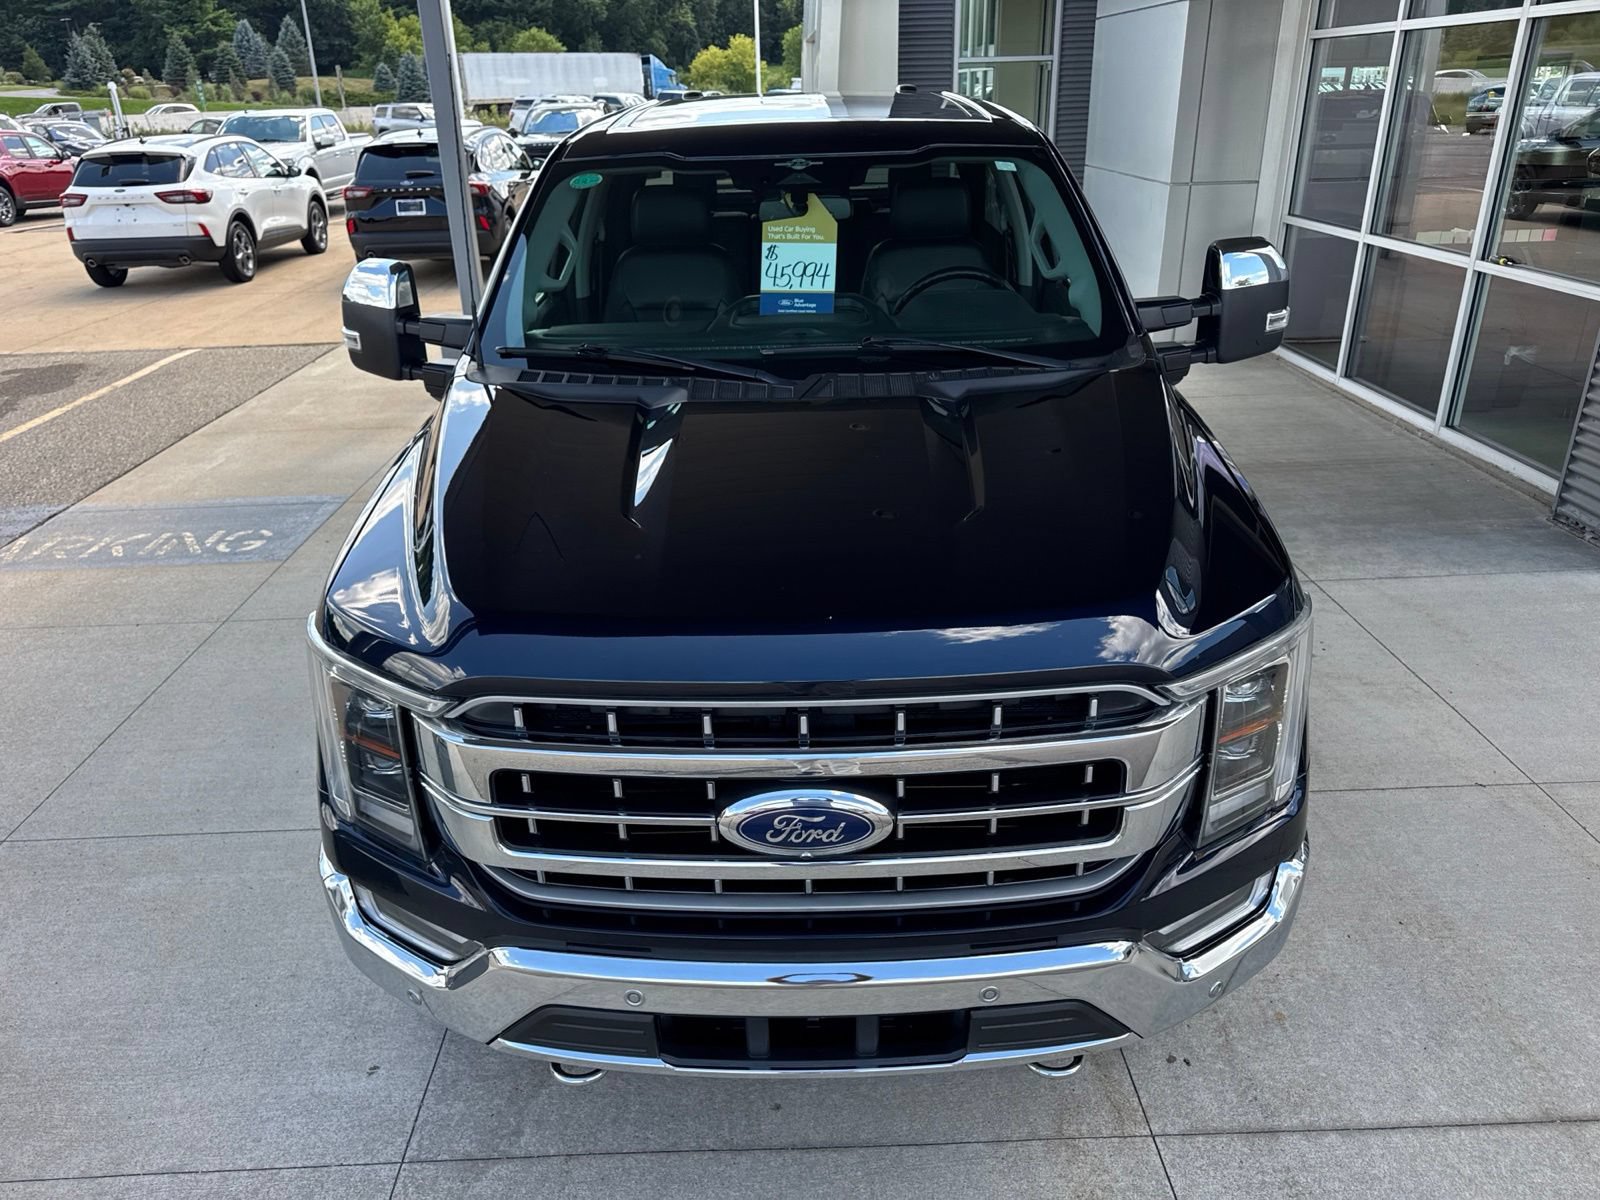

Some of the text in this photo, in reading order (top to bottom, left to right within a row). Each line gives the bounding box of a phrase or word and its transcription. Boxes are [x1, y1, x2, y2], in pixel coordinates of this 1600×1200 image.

[795, 225, 816, 234] Buying
[765, 244, 779, 261] $
[765, 260, 831, 290] 45,994
[765, 814, 845, 843] Ford
